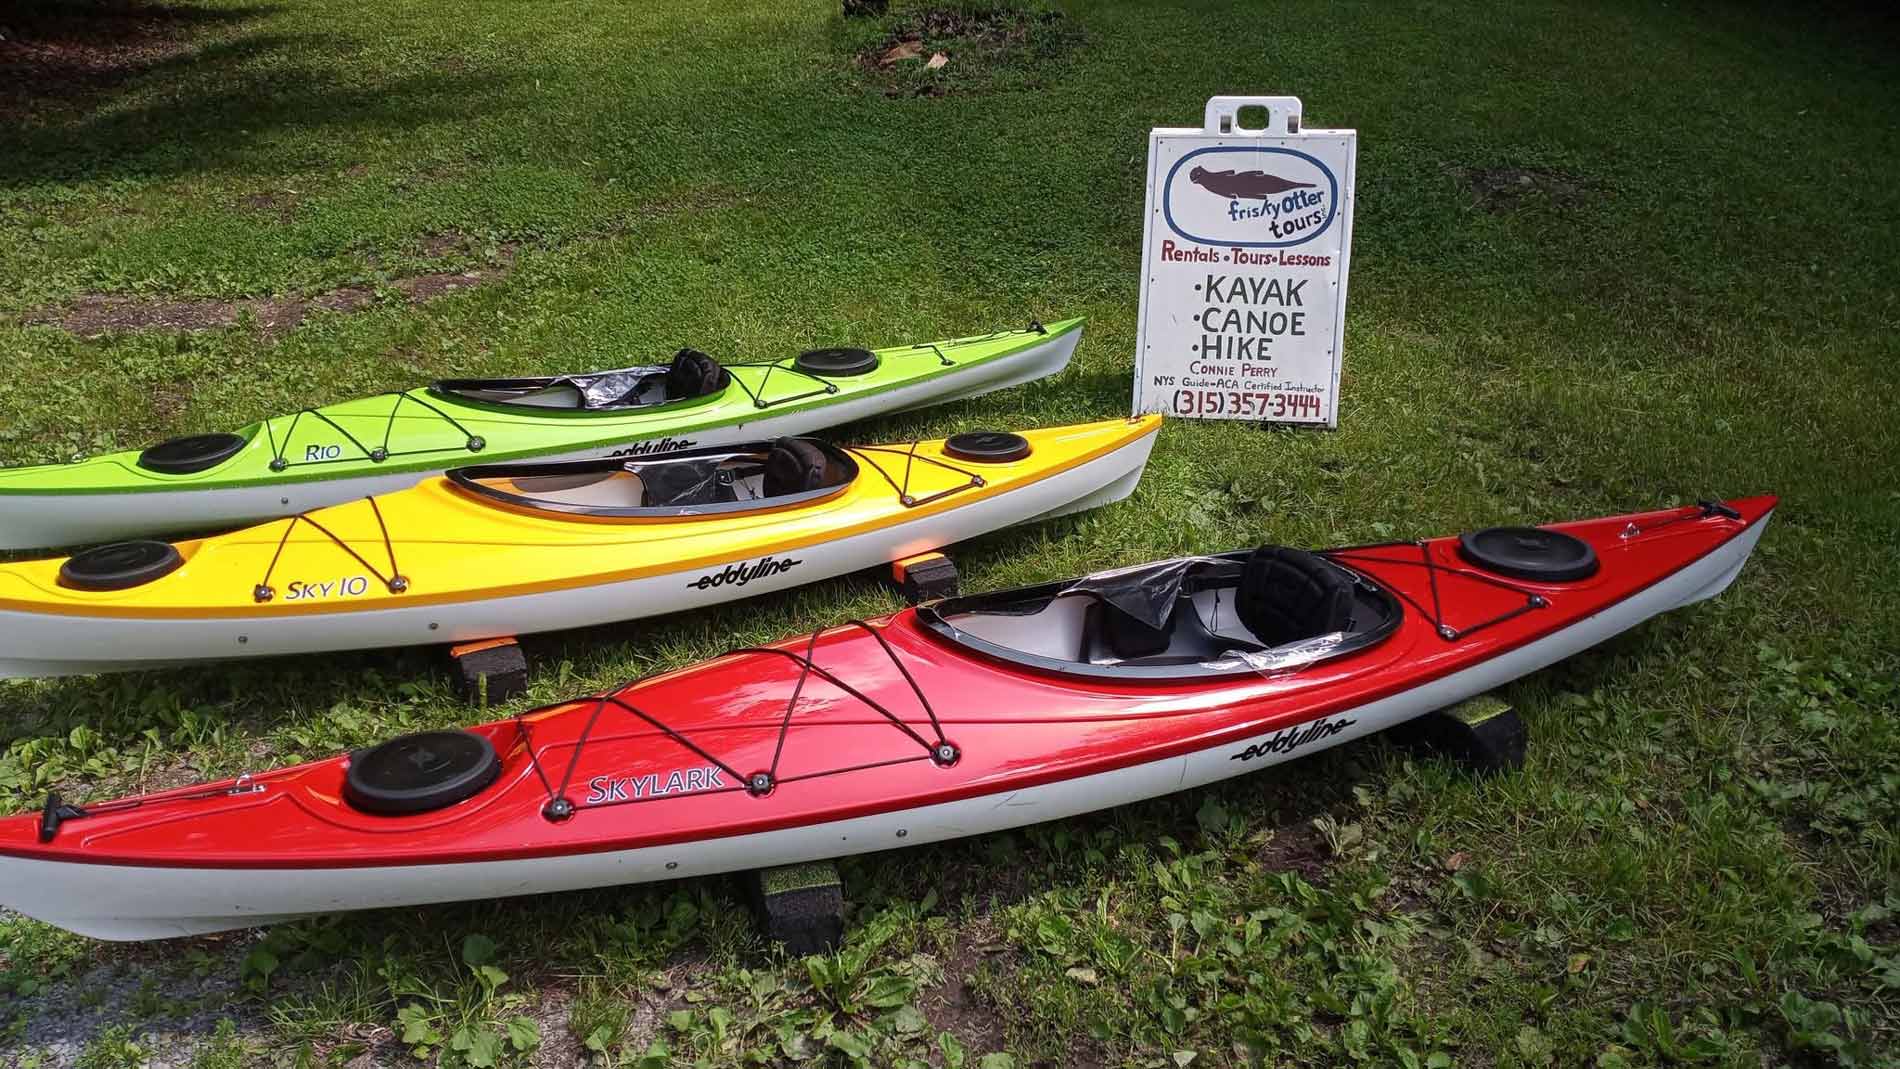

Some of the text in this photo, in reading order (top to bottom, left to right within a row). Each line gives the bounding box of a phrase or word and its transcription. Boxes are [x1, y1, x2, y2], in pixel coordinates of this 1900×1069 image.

[1269, 211, 1322, 239] tours
[1161, 239, 1220, 263] Rentals
[1205, 274, 1308, 307] KAYAK
[1201, 307, 1306, 336] CANOE
[1201, 335, 1273, 361] HIKE
[1190, 361, 1278, 378] CONNIE PERRY
[1154, 376, 1175, 387] NYS
[1244, 381, 1282, 391] Certified
[1283, 381, 1325, 393] Instructor
[587, 766, 724, 804] SKYLARK
